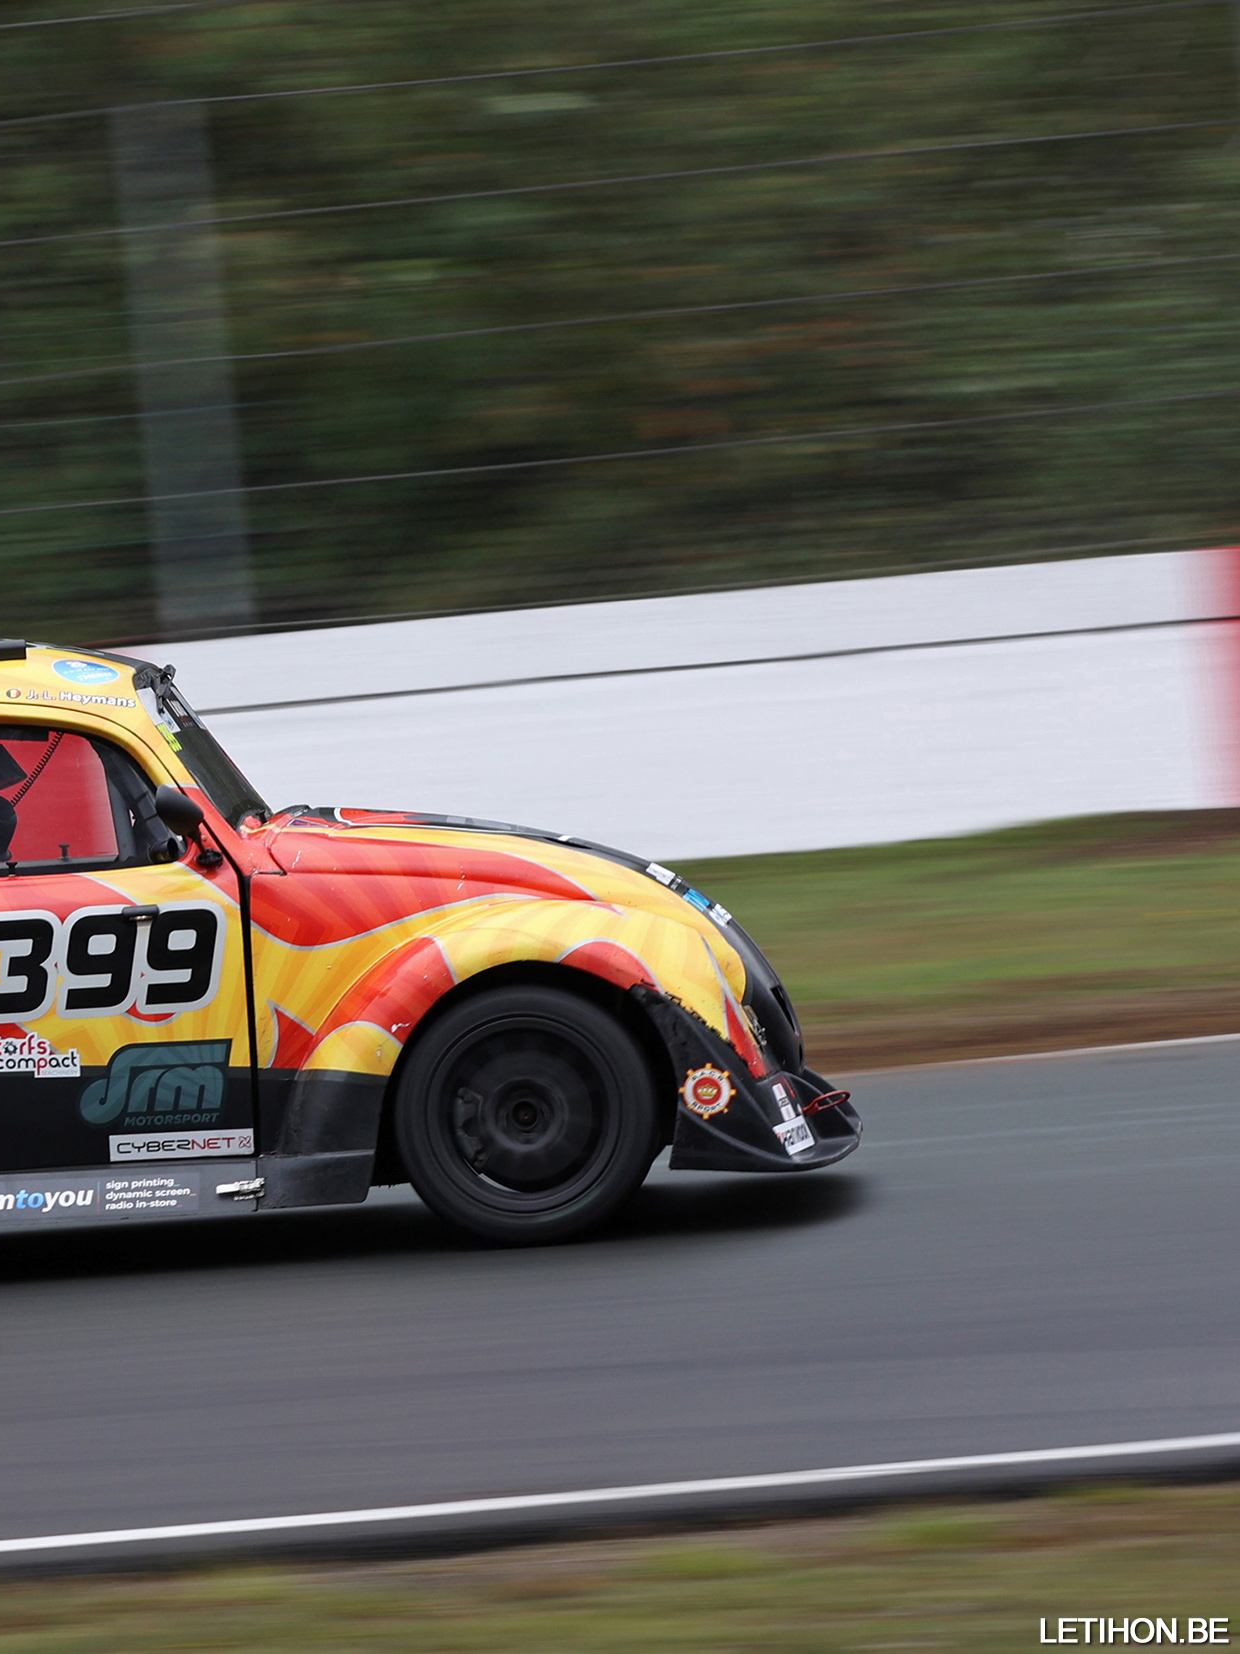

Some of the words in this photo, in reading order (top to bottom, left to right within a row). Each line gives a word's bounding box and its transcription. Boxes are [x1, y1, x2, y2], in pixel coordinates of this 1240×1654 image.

[59, 692, 136, 708] Heymans
[123, 1112, 220, 1127] MOTORSPORT
[117, 1137, 235, 1154] CYBERNET
[105, 1180, 129, 1190] sign
[105, 1189, 153, 1201] dynamic
[105, 1201, 134, 1210] radio
